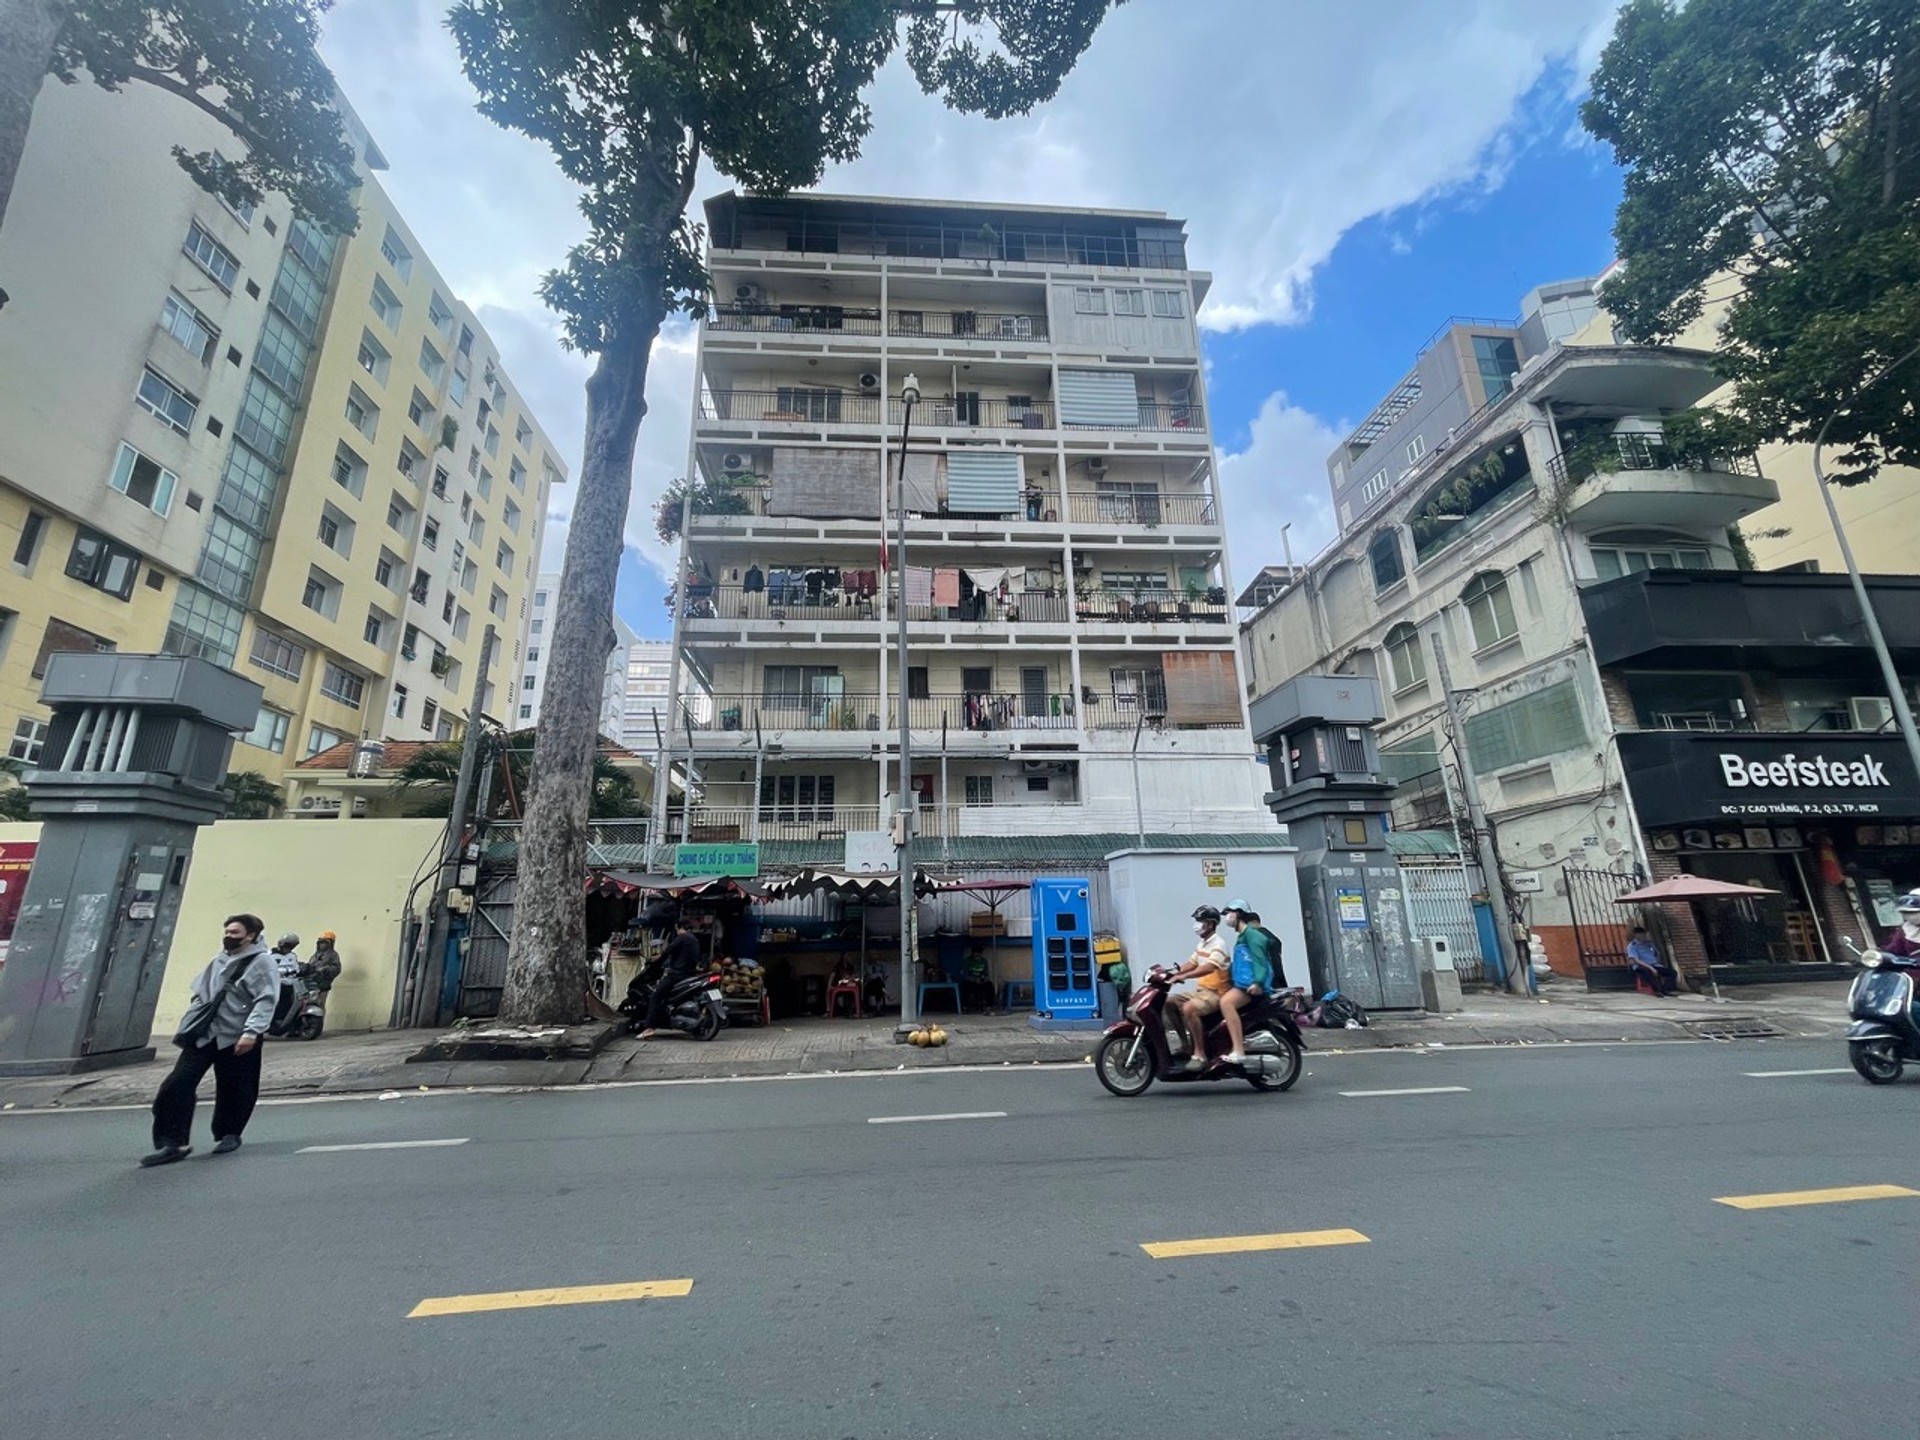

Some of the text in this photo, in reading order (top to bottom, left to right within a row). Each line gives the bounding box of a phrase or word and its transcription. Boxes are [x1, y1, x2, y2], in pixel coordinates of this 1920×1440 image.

[1719, 753, 1890, 788] Beefsteak
[1740, 805, 1746, 814] 7
[1747, 805, 1768, 813] CAO
